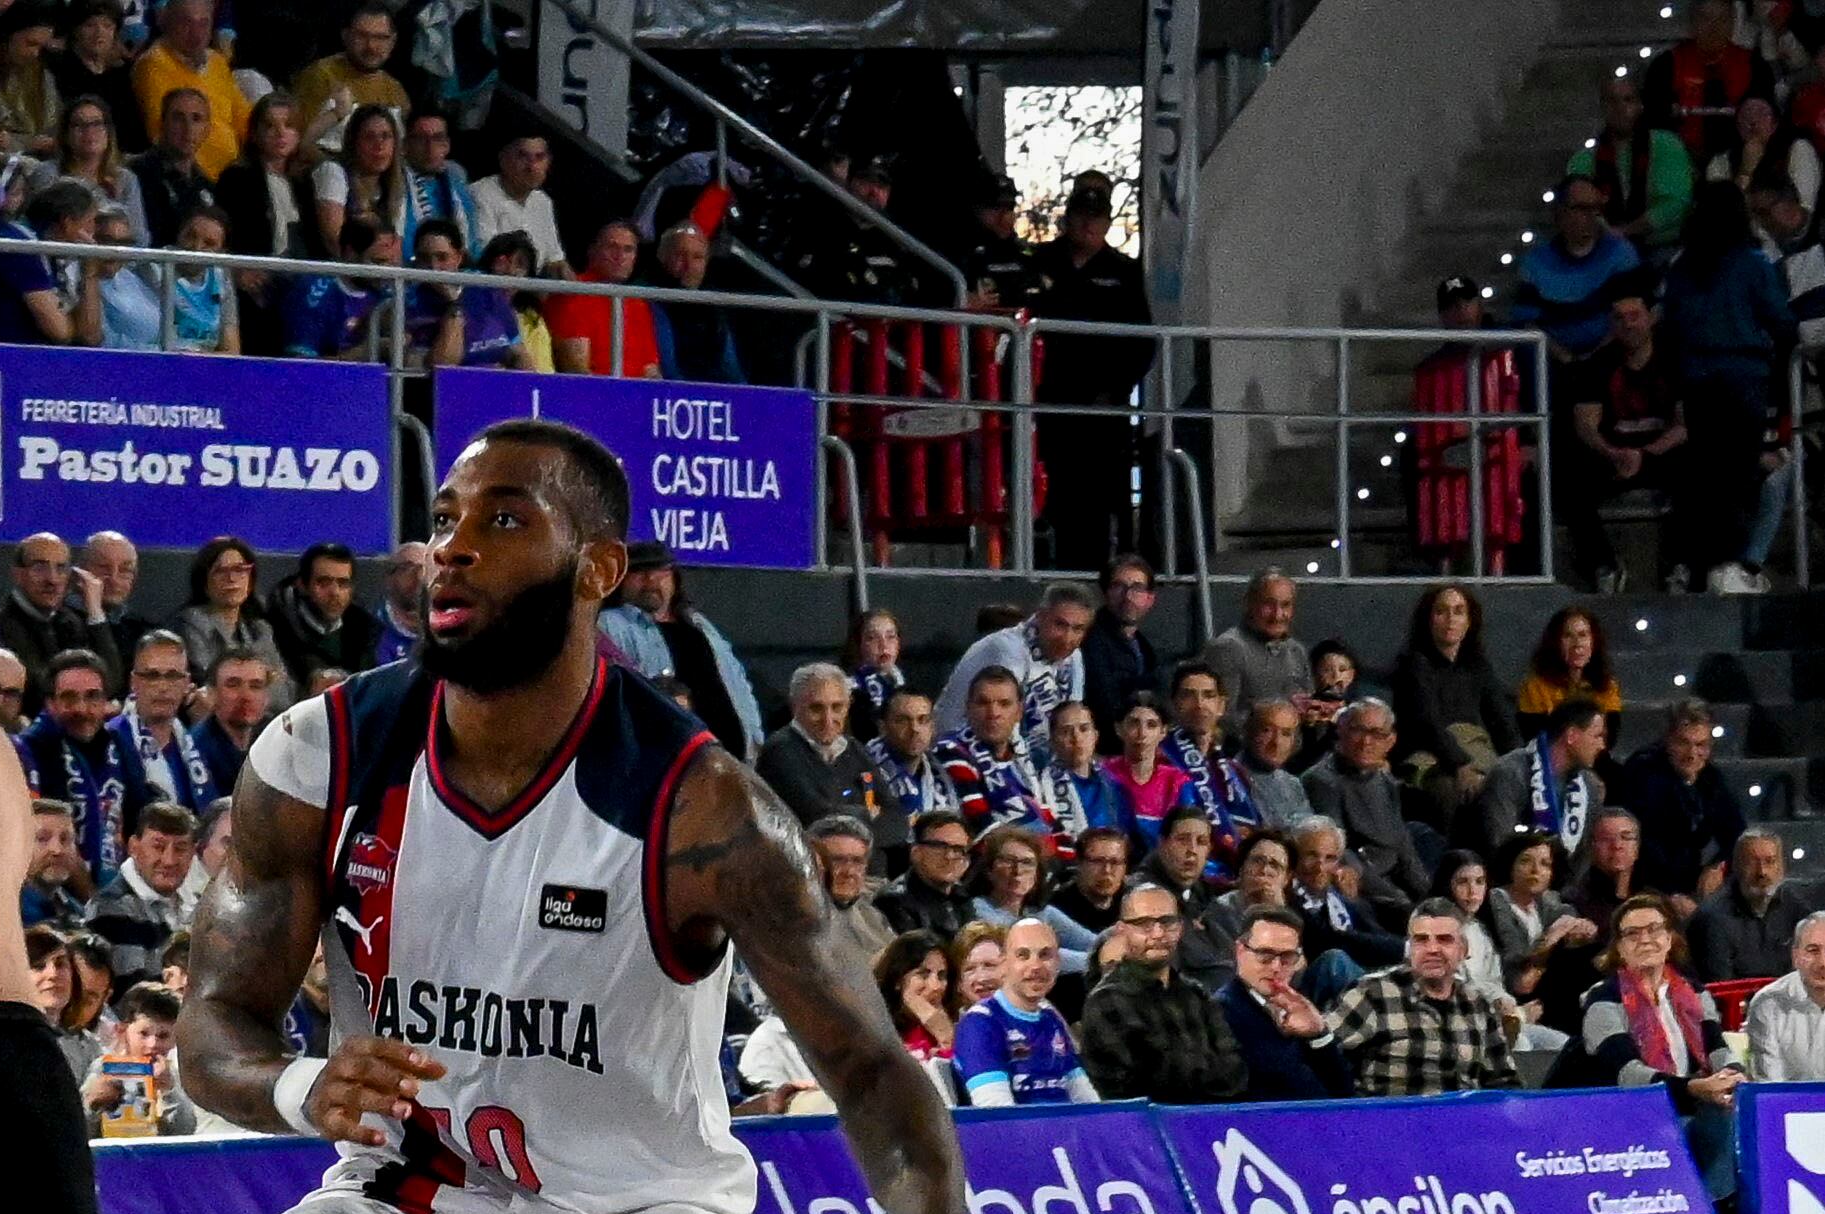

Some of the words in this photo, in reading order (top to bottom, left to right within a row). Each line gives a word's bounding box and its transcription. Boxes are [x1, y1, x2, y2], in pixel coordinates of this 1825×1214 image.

[22, 397, 128, 426] FERRETERÍA
[131, 404, 225, 430] INDUSTRIAL
[652, 398, 741, 443] HOTEL
[18, 436, 191, 486] Pastor
[200, 443, 379, 493] SUAZO
[652, 453, 782, 500] CASTILLA
[651, 507, 730, 552] VIEJA
[1515, 1151, 1583, 1178] Servicios
